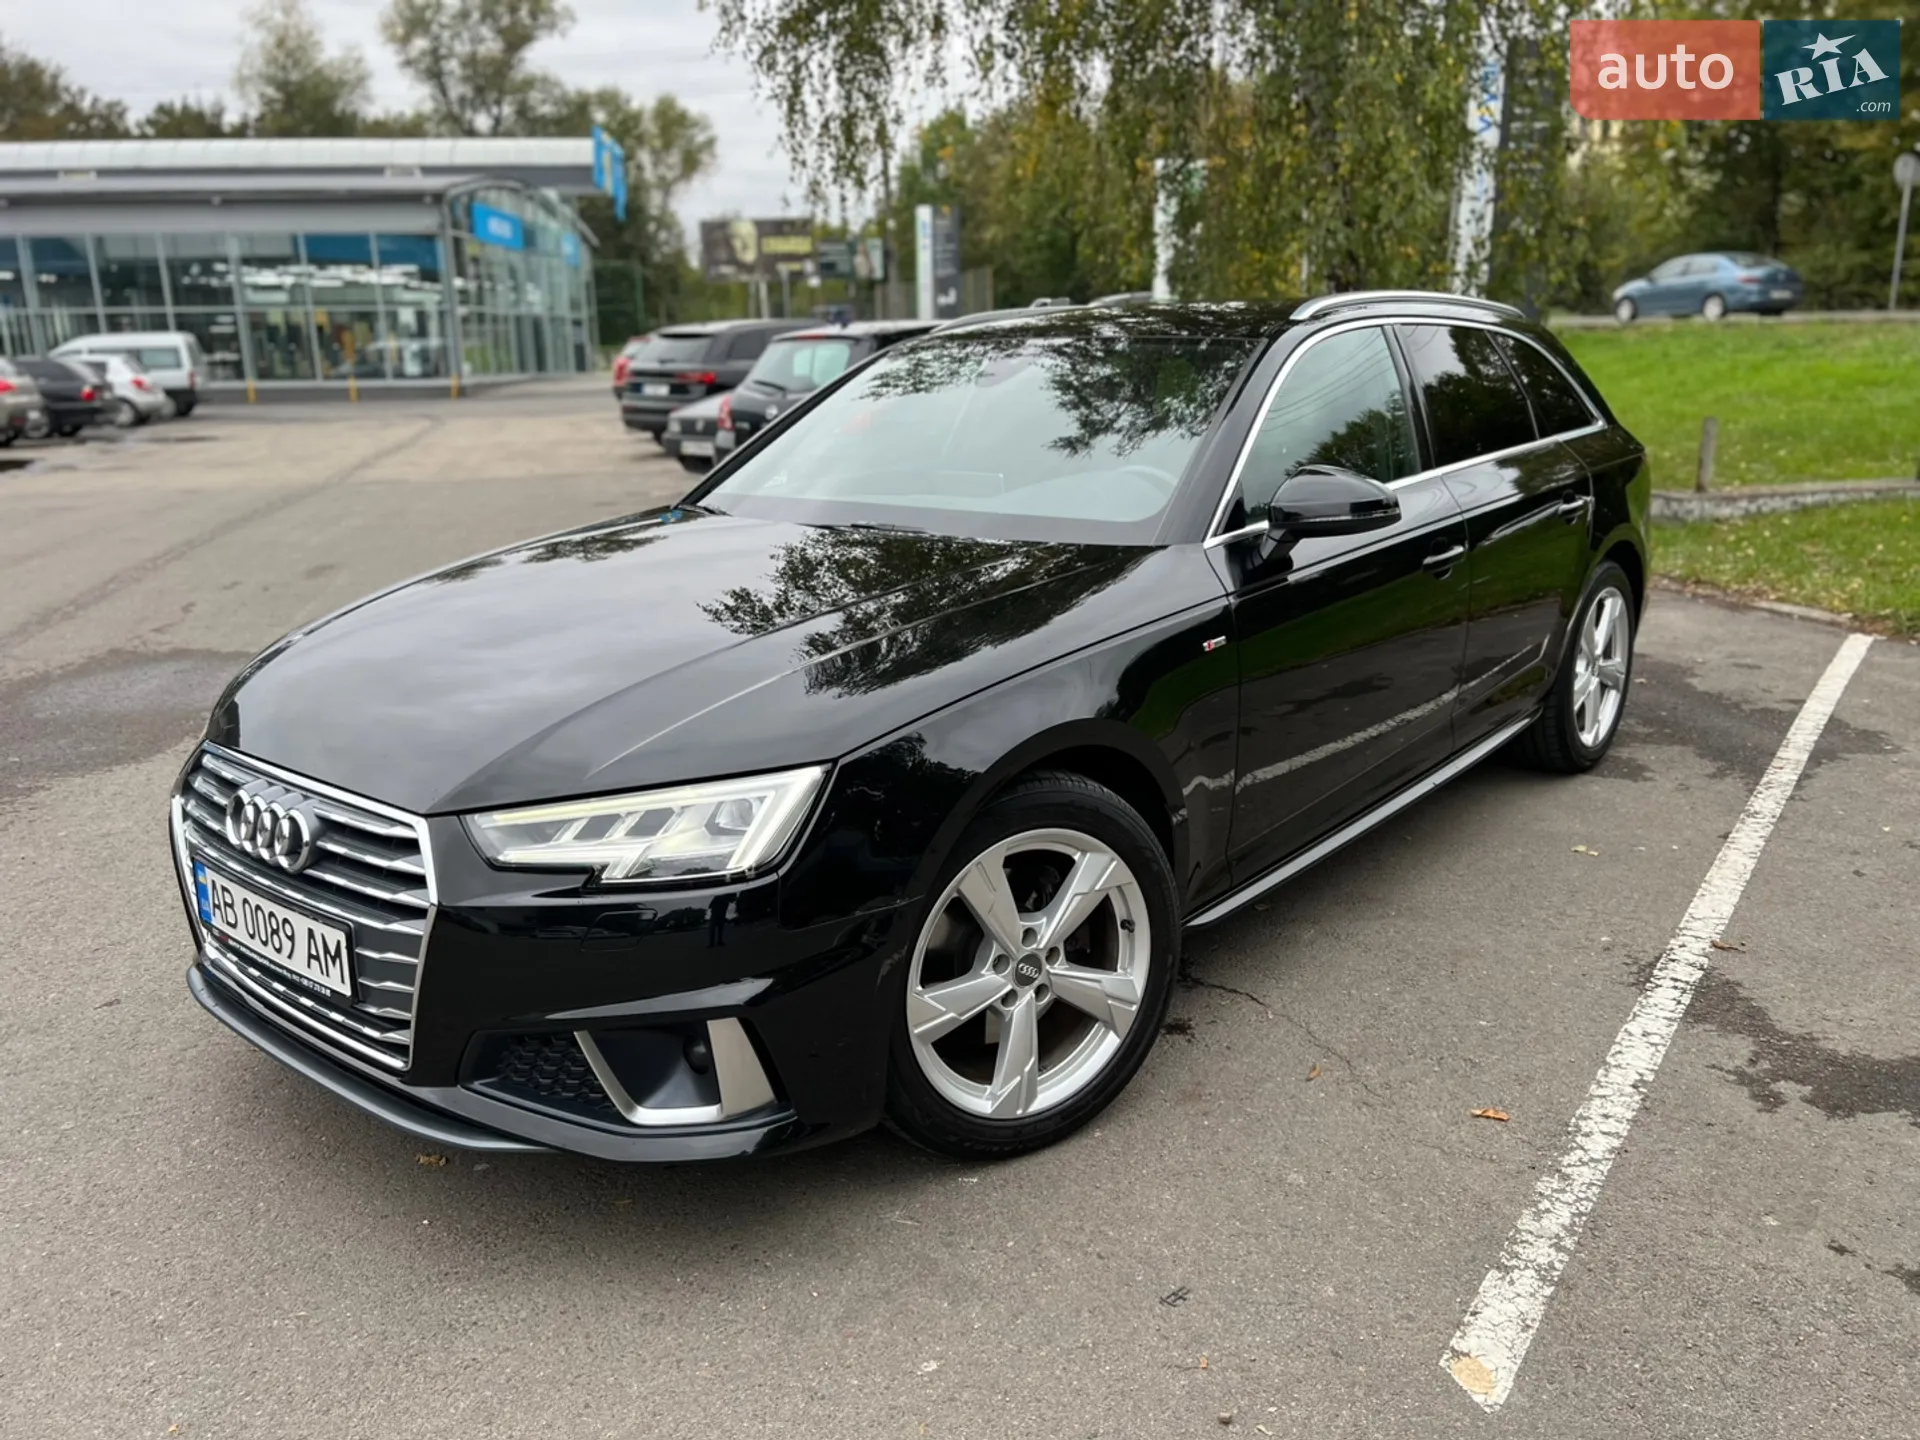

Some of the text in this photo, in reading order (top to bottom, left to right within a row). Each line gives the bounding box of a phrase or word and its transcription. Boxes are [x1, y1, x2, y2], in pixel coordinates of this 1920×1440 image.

[211, 879, 345, 985] AB 0089 AM
